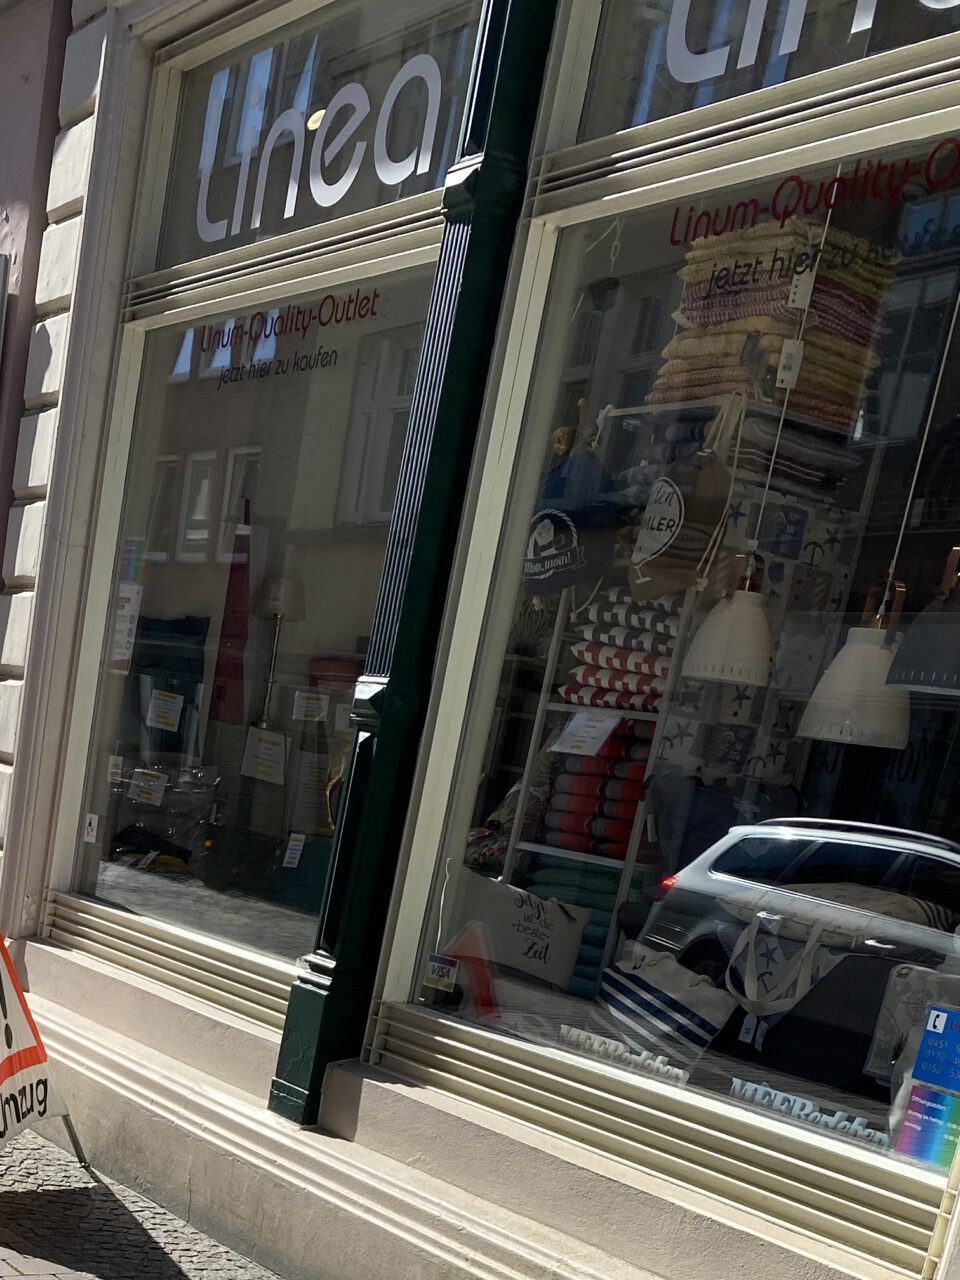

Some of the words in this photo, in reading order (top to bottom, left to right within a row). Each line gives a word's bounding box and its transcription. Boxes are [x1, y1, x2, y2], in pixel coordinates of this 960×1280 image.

[197, 53, 442, 243] Linea
[702, 256, 763, 300] jetzt
[770, 247, 821, 278] hier
[200, 288, 380, 352] Linum-Quality-Outlet
[217, 363, 246, 390] jetzt
[248, 361, 272, 379] hier
[275, 358, 289, 376] zu
[292, 345, 338, 372] kaufen
[431, 964, 451, 980] VISA
